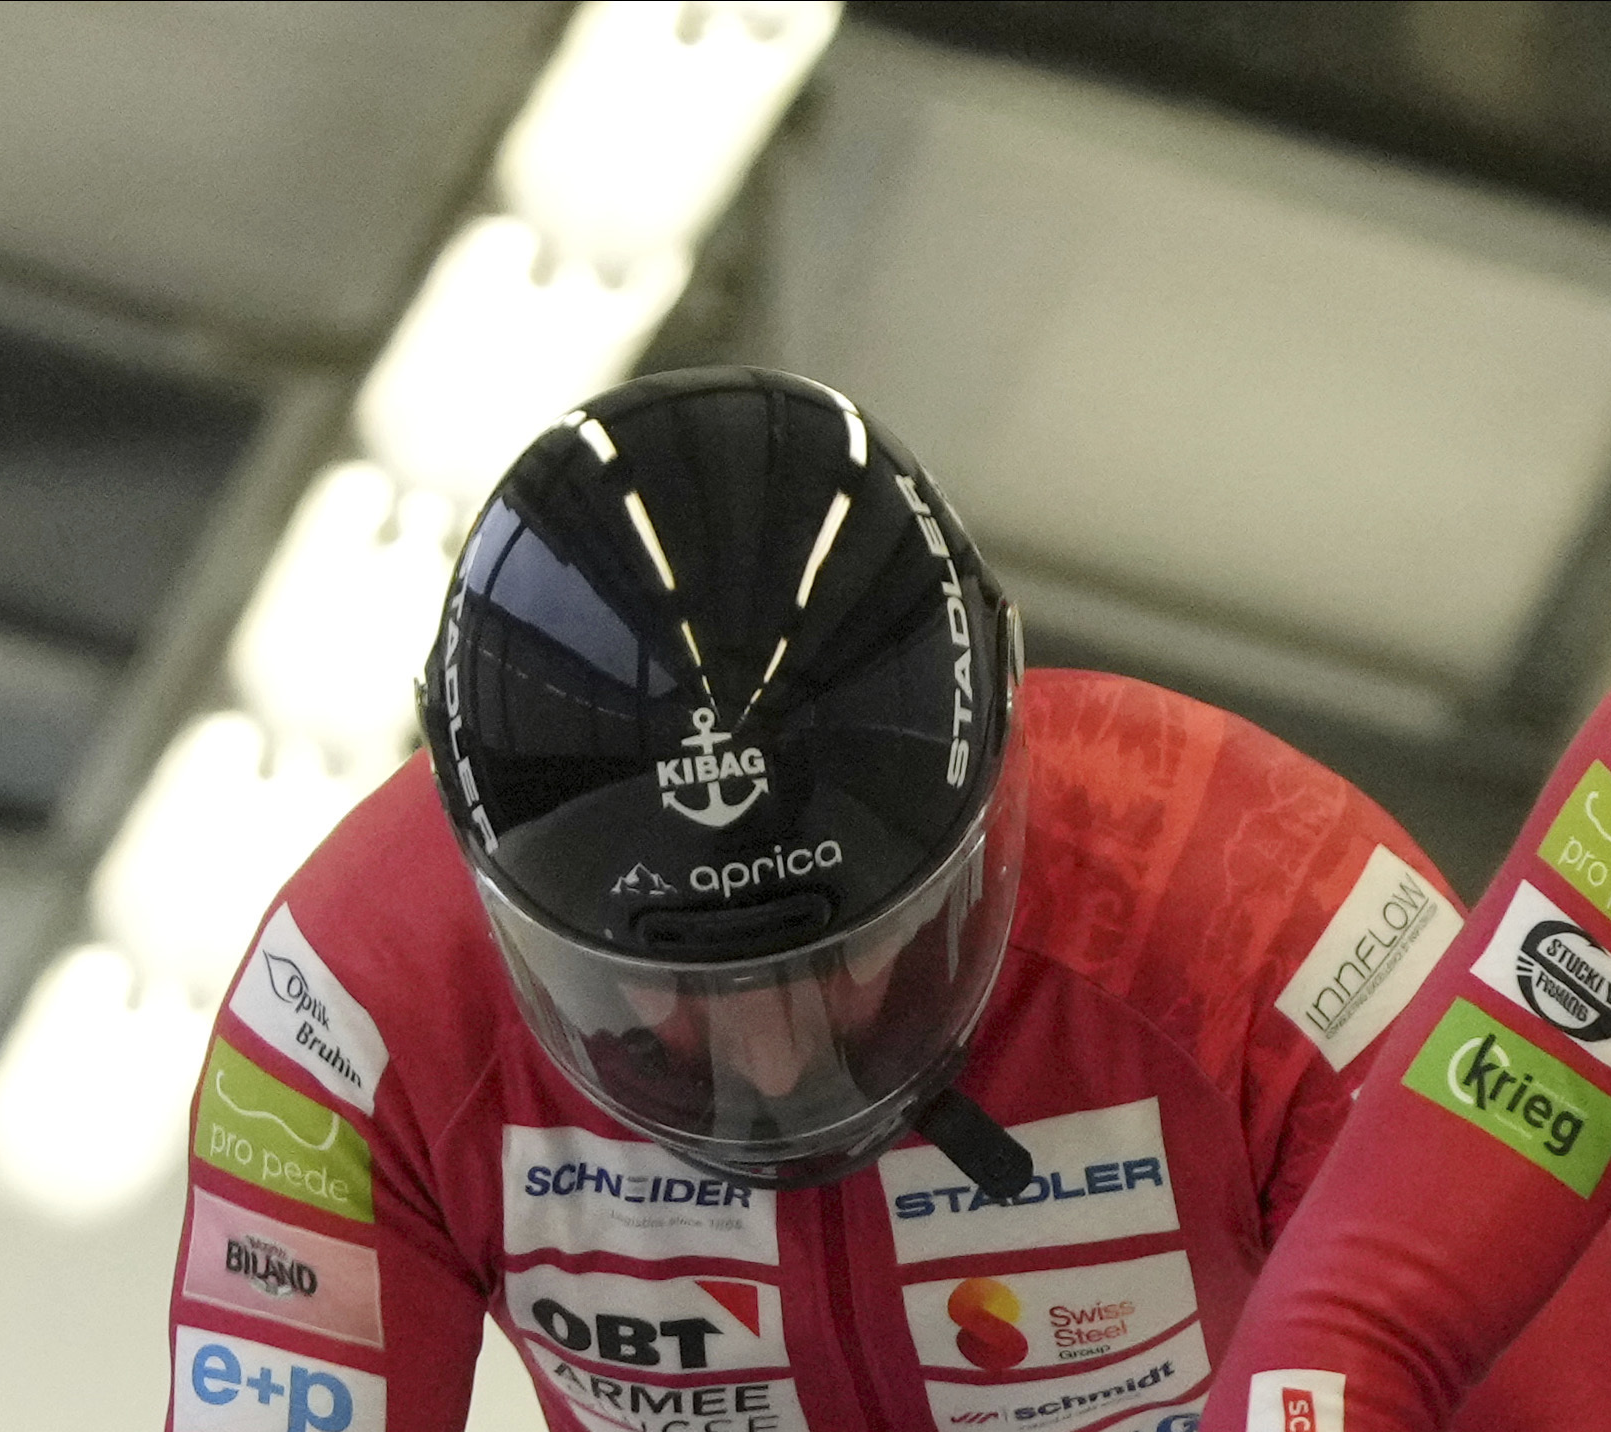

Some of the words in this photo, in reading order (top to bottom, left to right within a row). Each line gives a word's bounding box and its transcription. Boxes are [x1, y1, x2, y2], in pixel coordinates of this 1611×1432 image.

[896, 474, 972, 788] STADLER
[657, 748, 766, 789] KIBAG
[689, 838, 843, 899] aprica
[1558, 836, 1608, 887] pro
[1547, 939, 1606, 993] STUCKI
[286, 973, 331, 1031] Optik
[295, 1021, 362, 1087] Bruhin
[1463, 1033, 1584, 1157] krieg
[209, 1121, 253, 1168] pro
[262, 1149, 349, 1204] pede
[525, 1162, 752, 1209] SCHNEIDER
[226, 1239, 318, 1297] BILAND
[532, 1298, 725, 1369] OBT
[1049, 1300, 1136, 1328] Swiss
[1054, 1322, 1128, 1348] Steel
[1058, 1344, 1110, 1360] Group
[1014, 1360, 1175, 1422] schmidt
